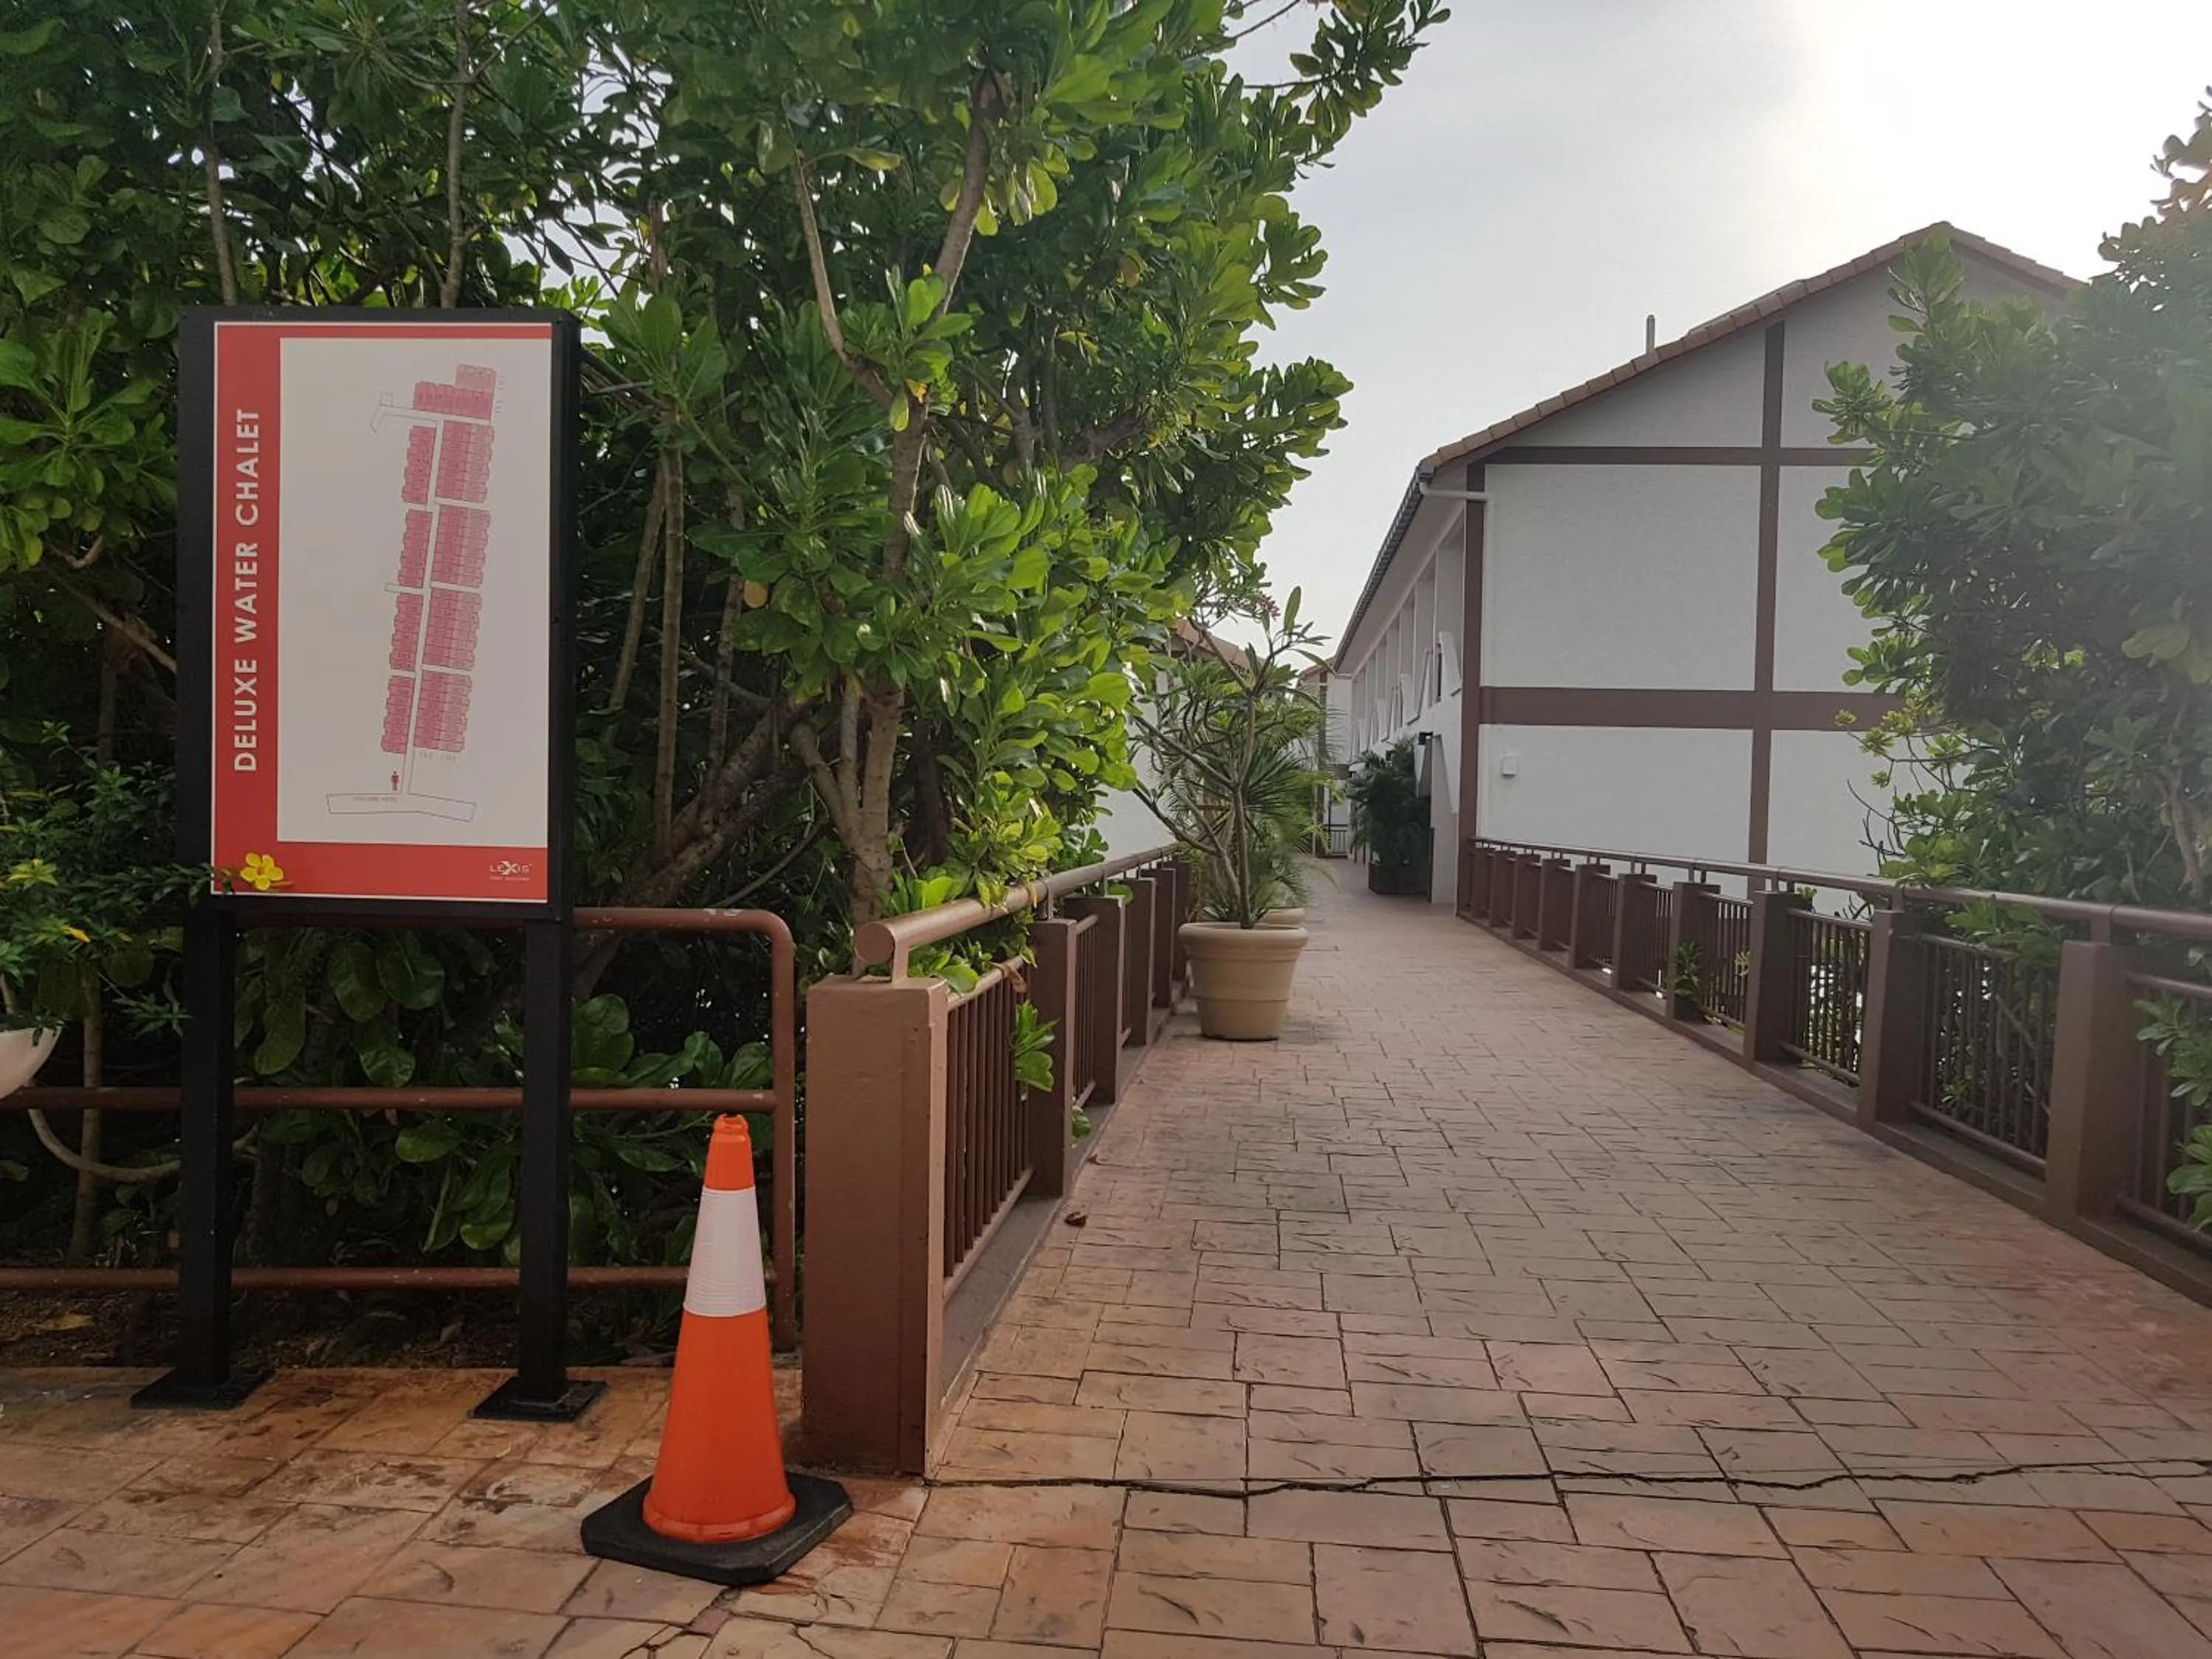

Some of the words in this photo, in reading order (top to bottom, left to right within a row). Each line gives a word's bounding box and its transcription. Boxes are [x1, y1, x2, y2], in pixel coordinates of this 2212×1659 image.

[235, 408, 260, 526] CHALET
[234, 542, 258, 643] WATER
[234, 658, 257, 772] DELUXE
